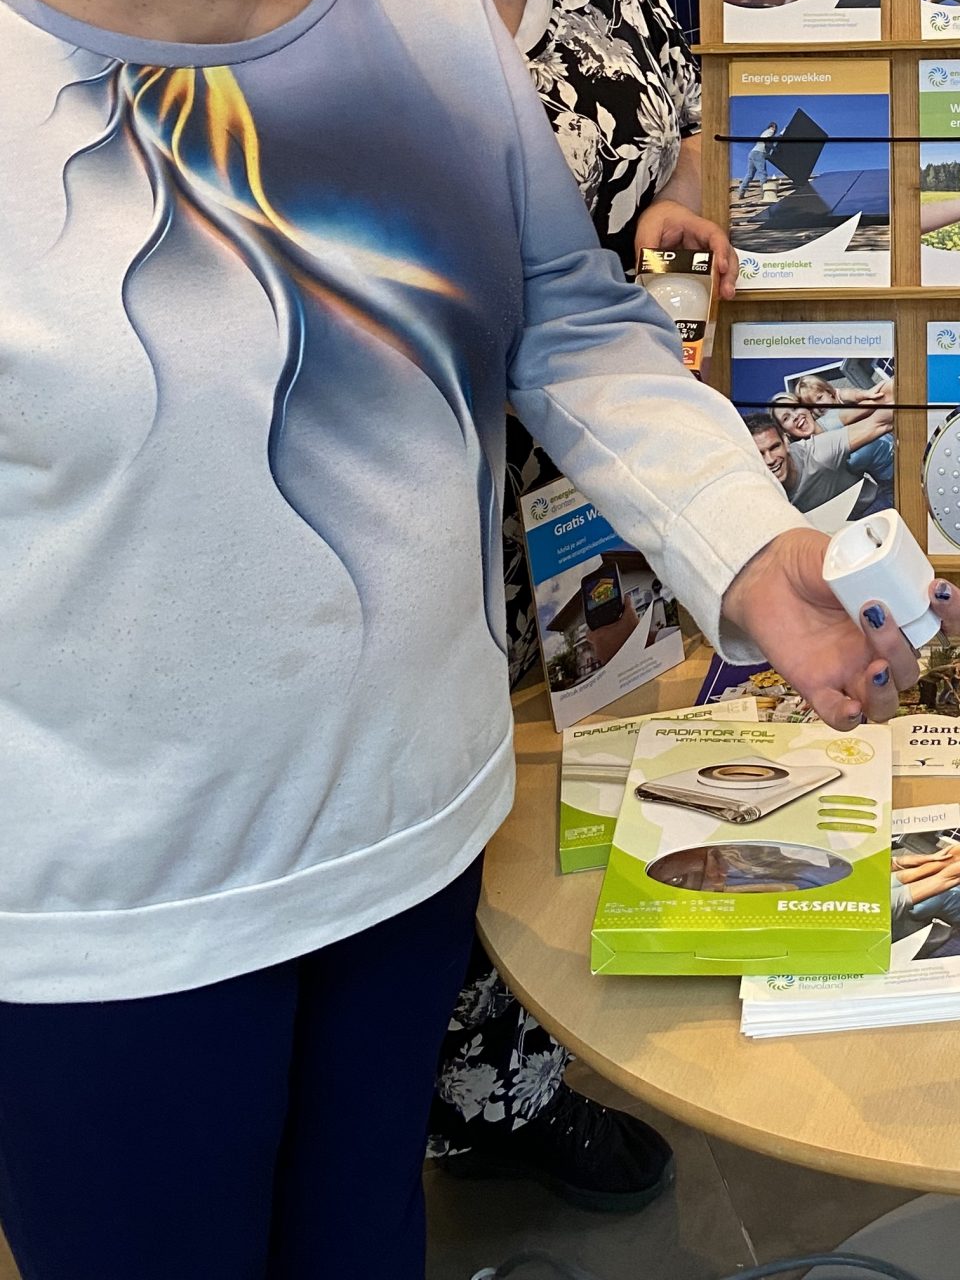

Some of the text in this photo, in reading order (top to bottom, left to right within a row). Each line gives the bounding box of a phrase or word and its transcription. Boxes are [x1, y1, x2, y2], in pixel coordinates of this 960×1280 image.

[741, 72, 832, 86] Energie opwekken
[762, 260, 812, 271] energieloket
[762, 269, 794, 279] dronten
[743, 335, 882, 348] energieloket flevoland helpt!
[550, 497, 576, 513] dronten
[554, 514, 585, 536] Gratis
[573, 721, 637, 738] DRAUGHT
[655, 728, 776, 738] RADIATOR FOIL
[911, 725, 960, 734] Plant
[909, 738, 941, 746] een
[913, 812, 947, 826] helpt!
[777, 899, 880, 914] ECOSAVERS
[798, 981, 844, 990] flevoland
